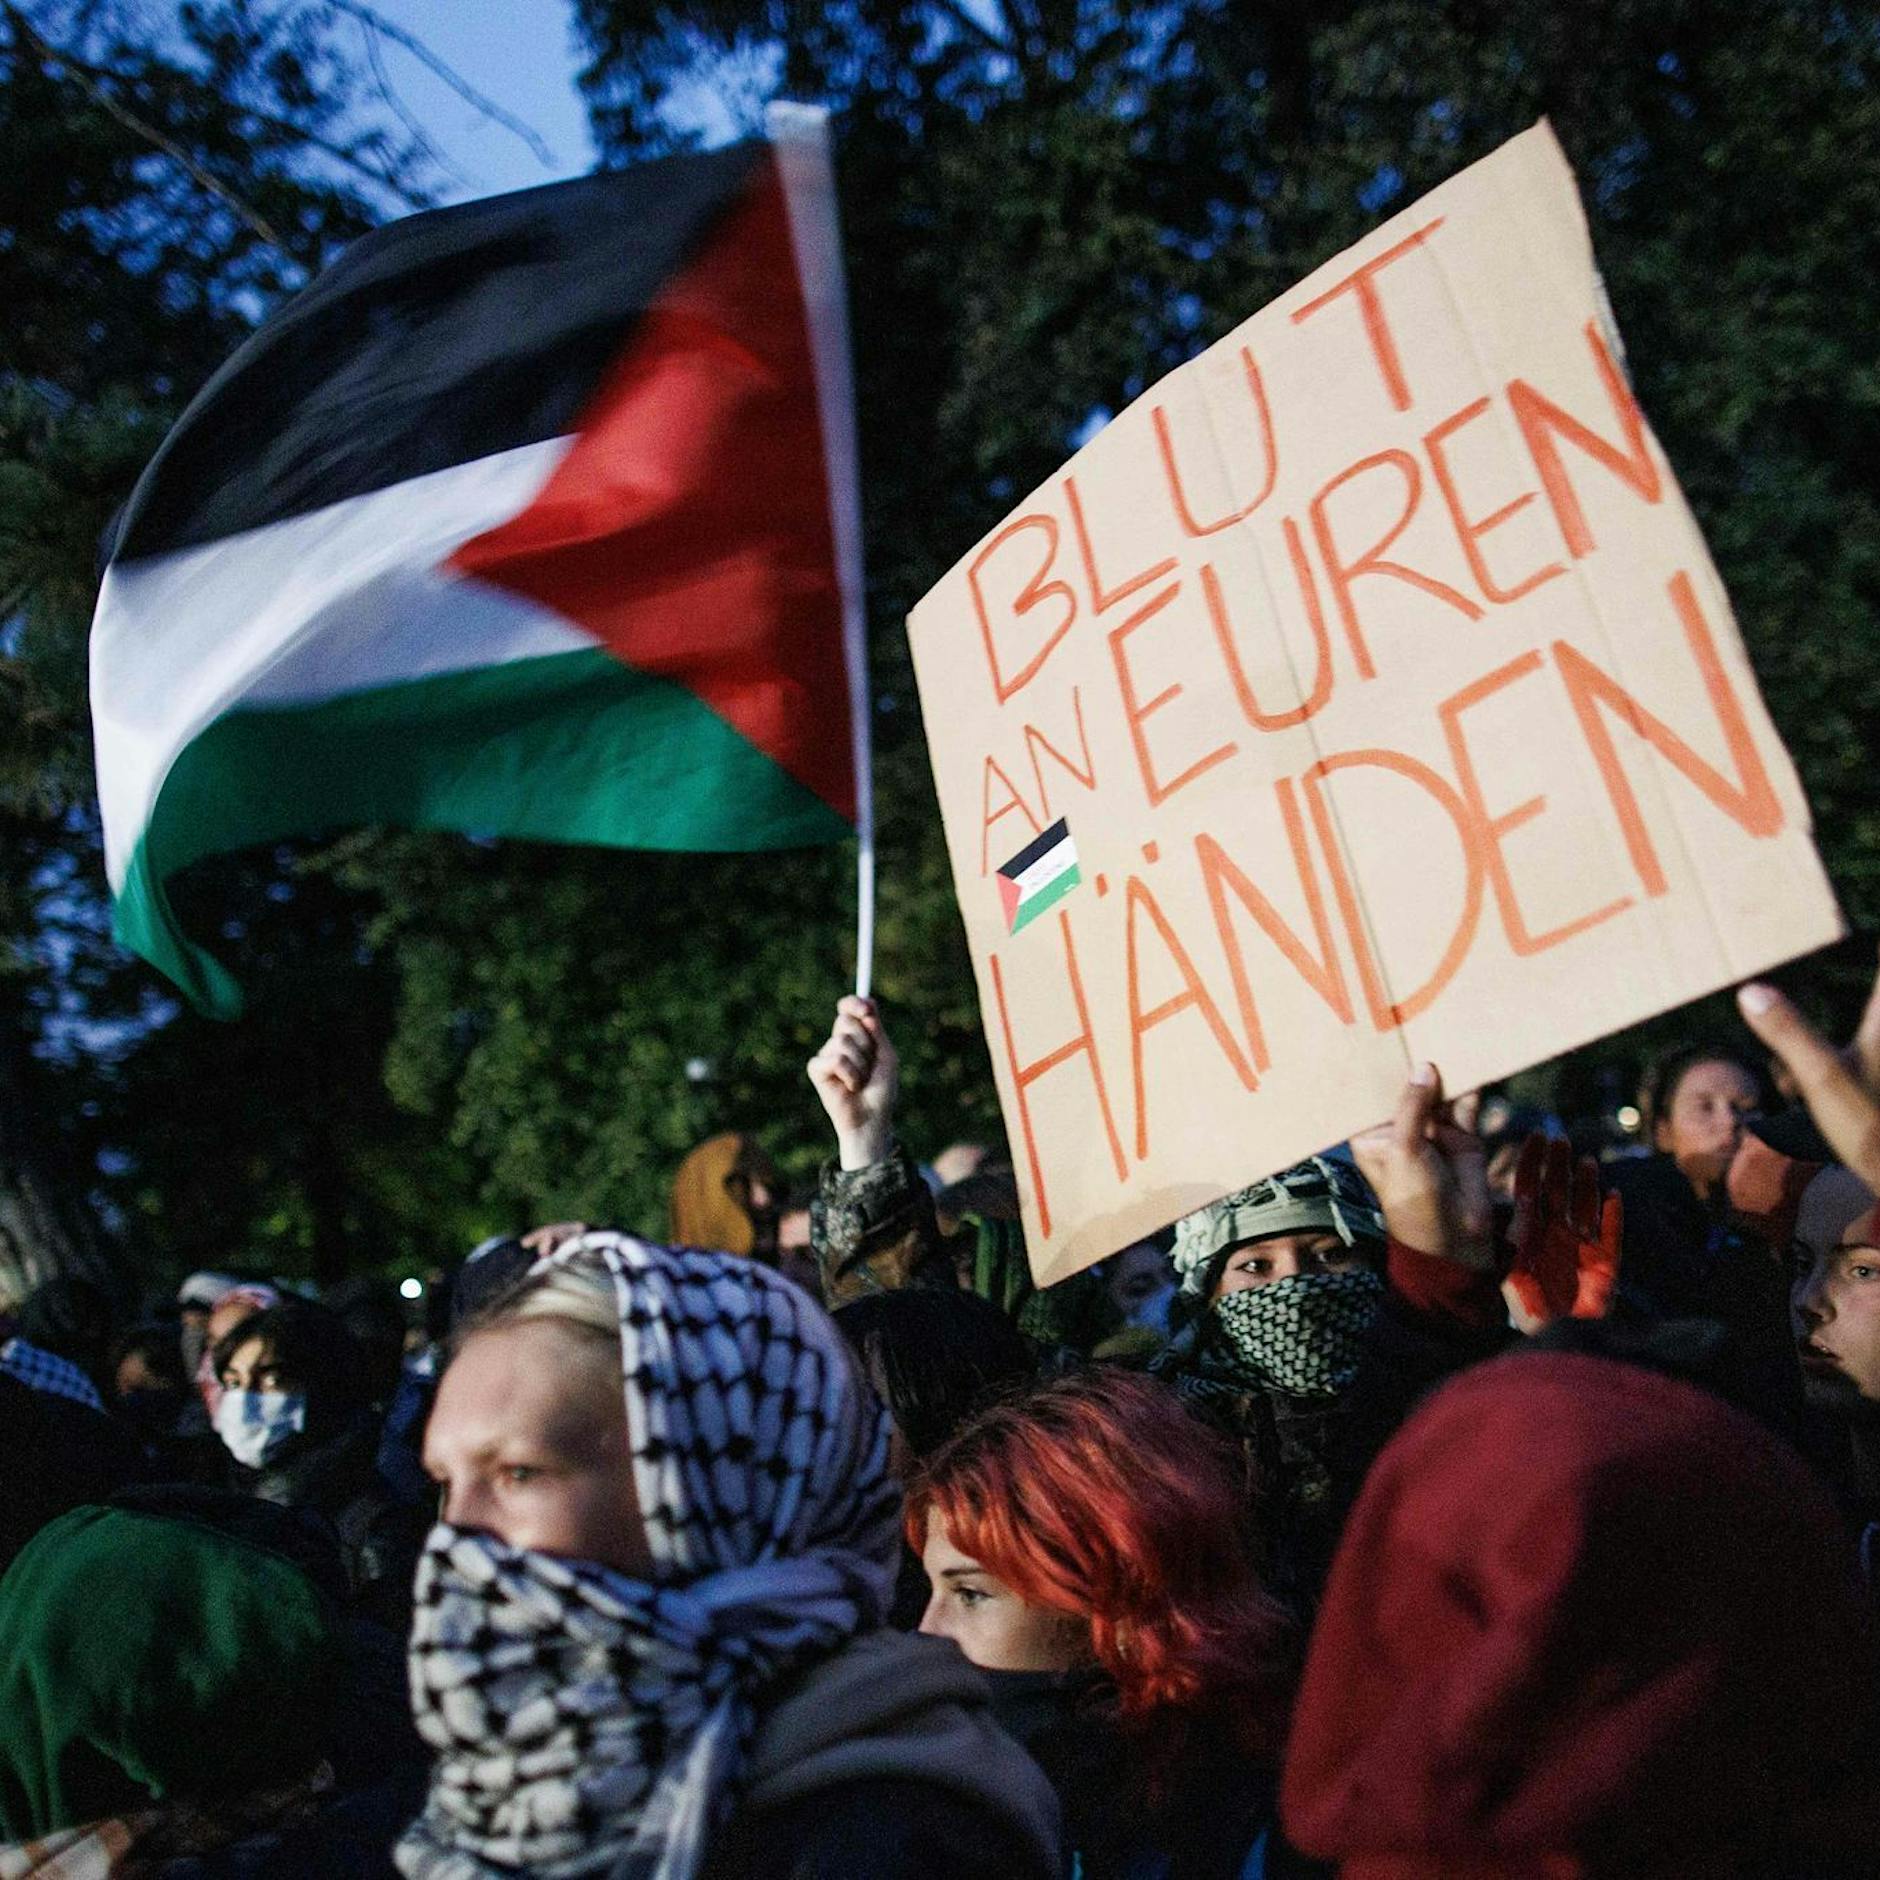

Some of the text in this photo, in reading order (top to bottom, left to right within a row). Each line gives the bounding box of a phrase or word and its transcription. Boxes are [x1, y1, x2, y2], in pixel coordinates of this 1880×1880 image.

[968, 218, 1446, 702] BLUT
[982, 320, 1662, 877] AN EUREN
[990, 572, 1784, 1237] HÄNDEN
